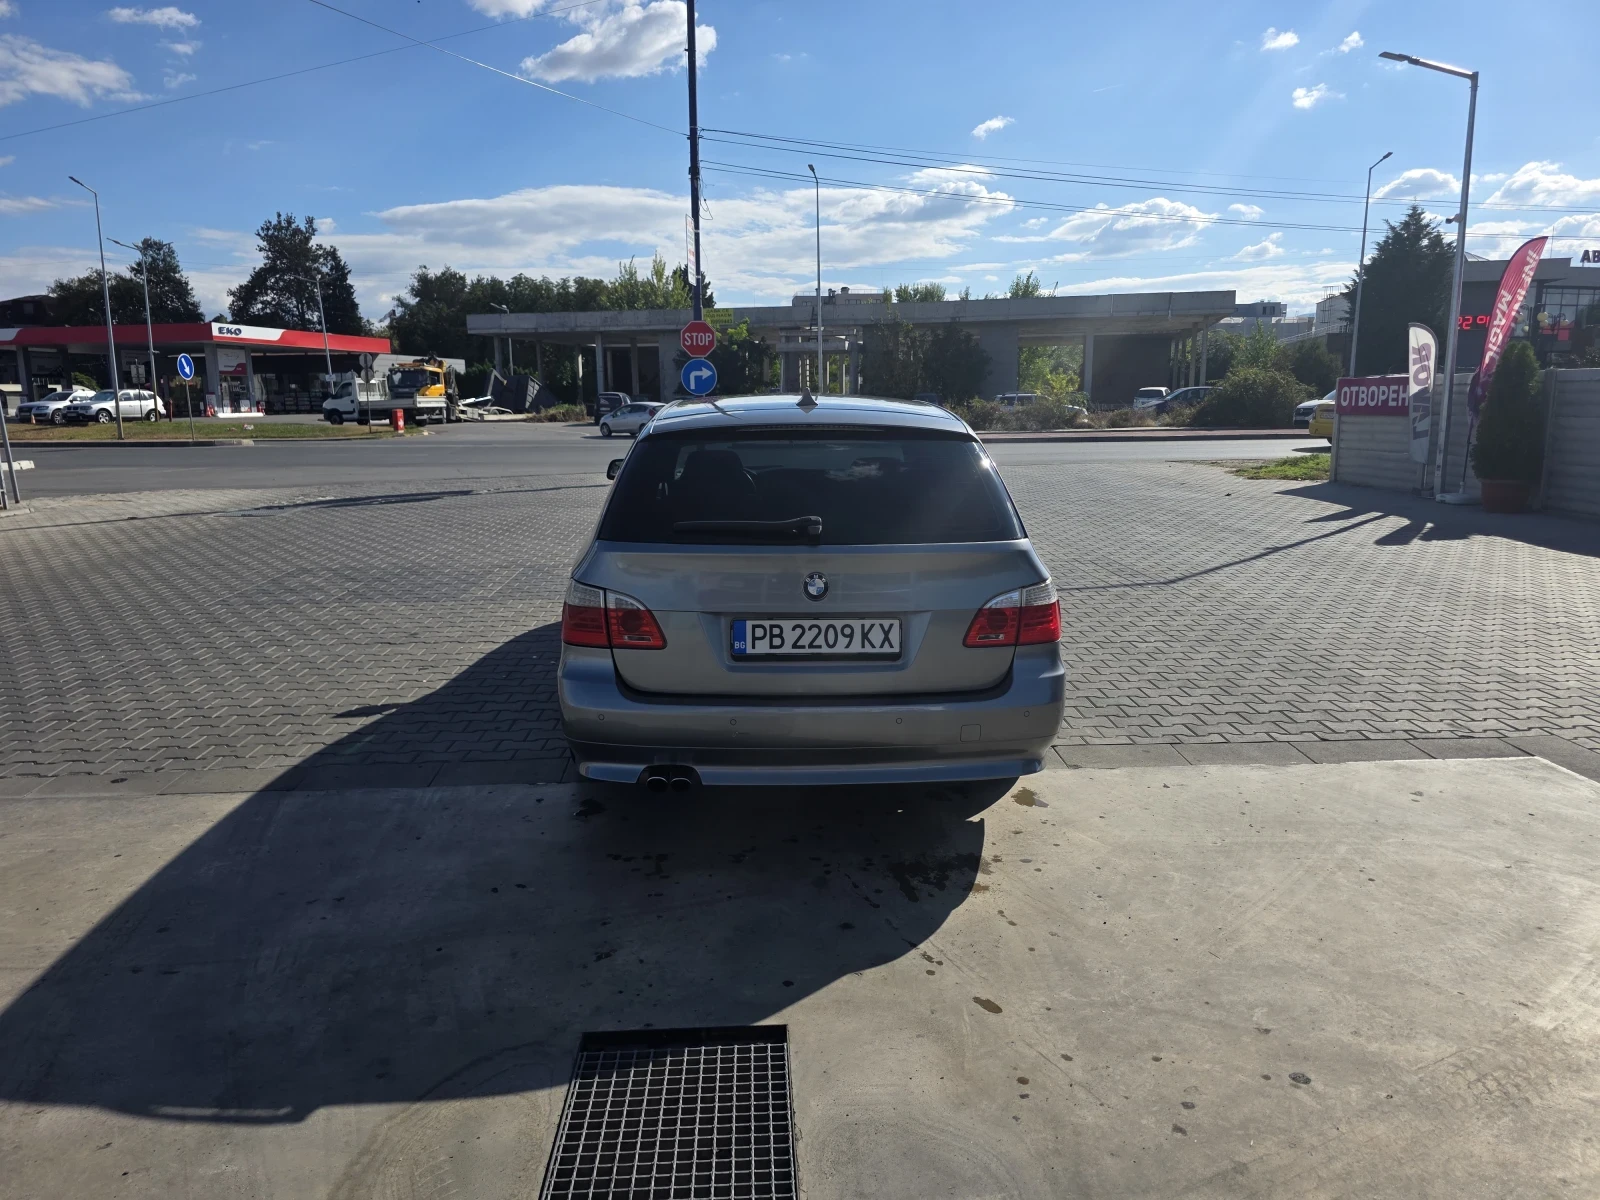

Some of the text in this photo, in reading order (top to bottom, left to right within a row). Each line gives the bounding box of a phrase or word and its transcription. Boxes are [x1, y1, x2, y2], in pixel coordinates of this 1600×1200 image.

[218, 326, 242, 336] EKO
[684, 332, 713, 346] STOP
[751, 622, 895, 650] PB 2209 KX
[734, 641, 746, 649] BG
